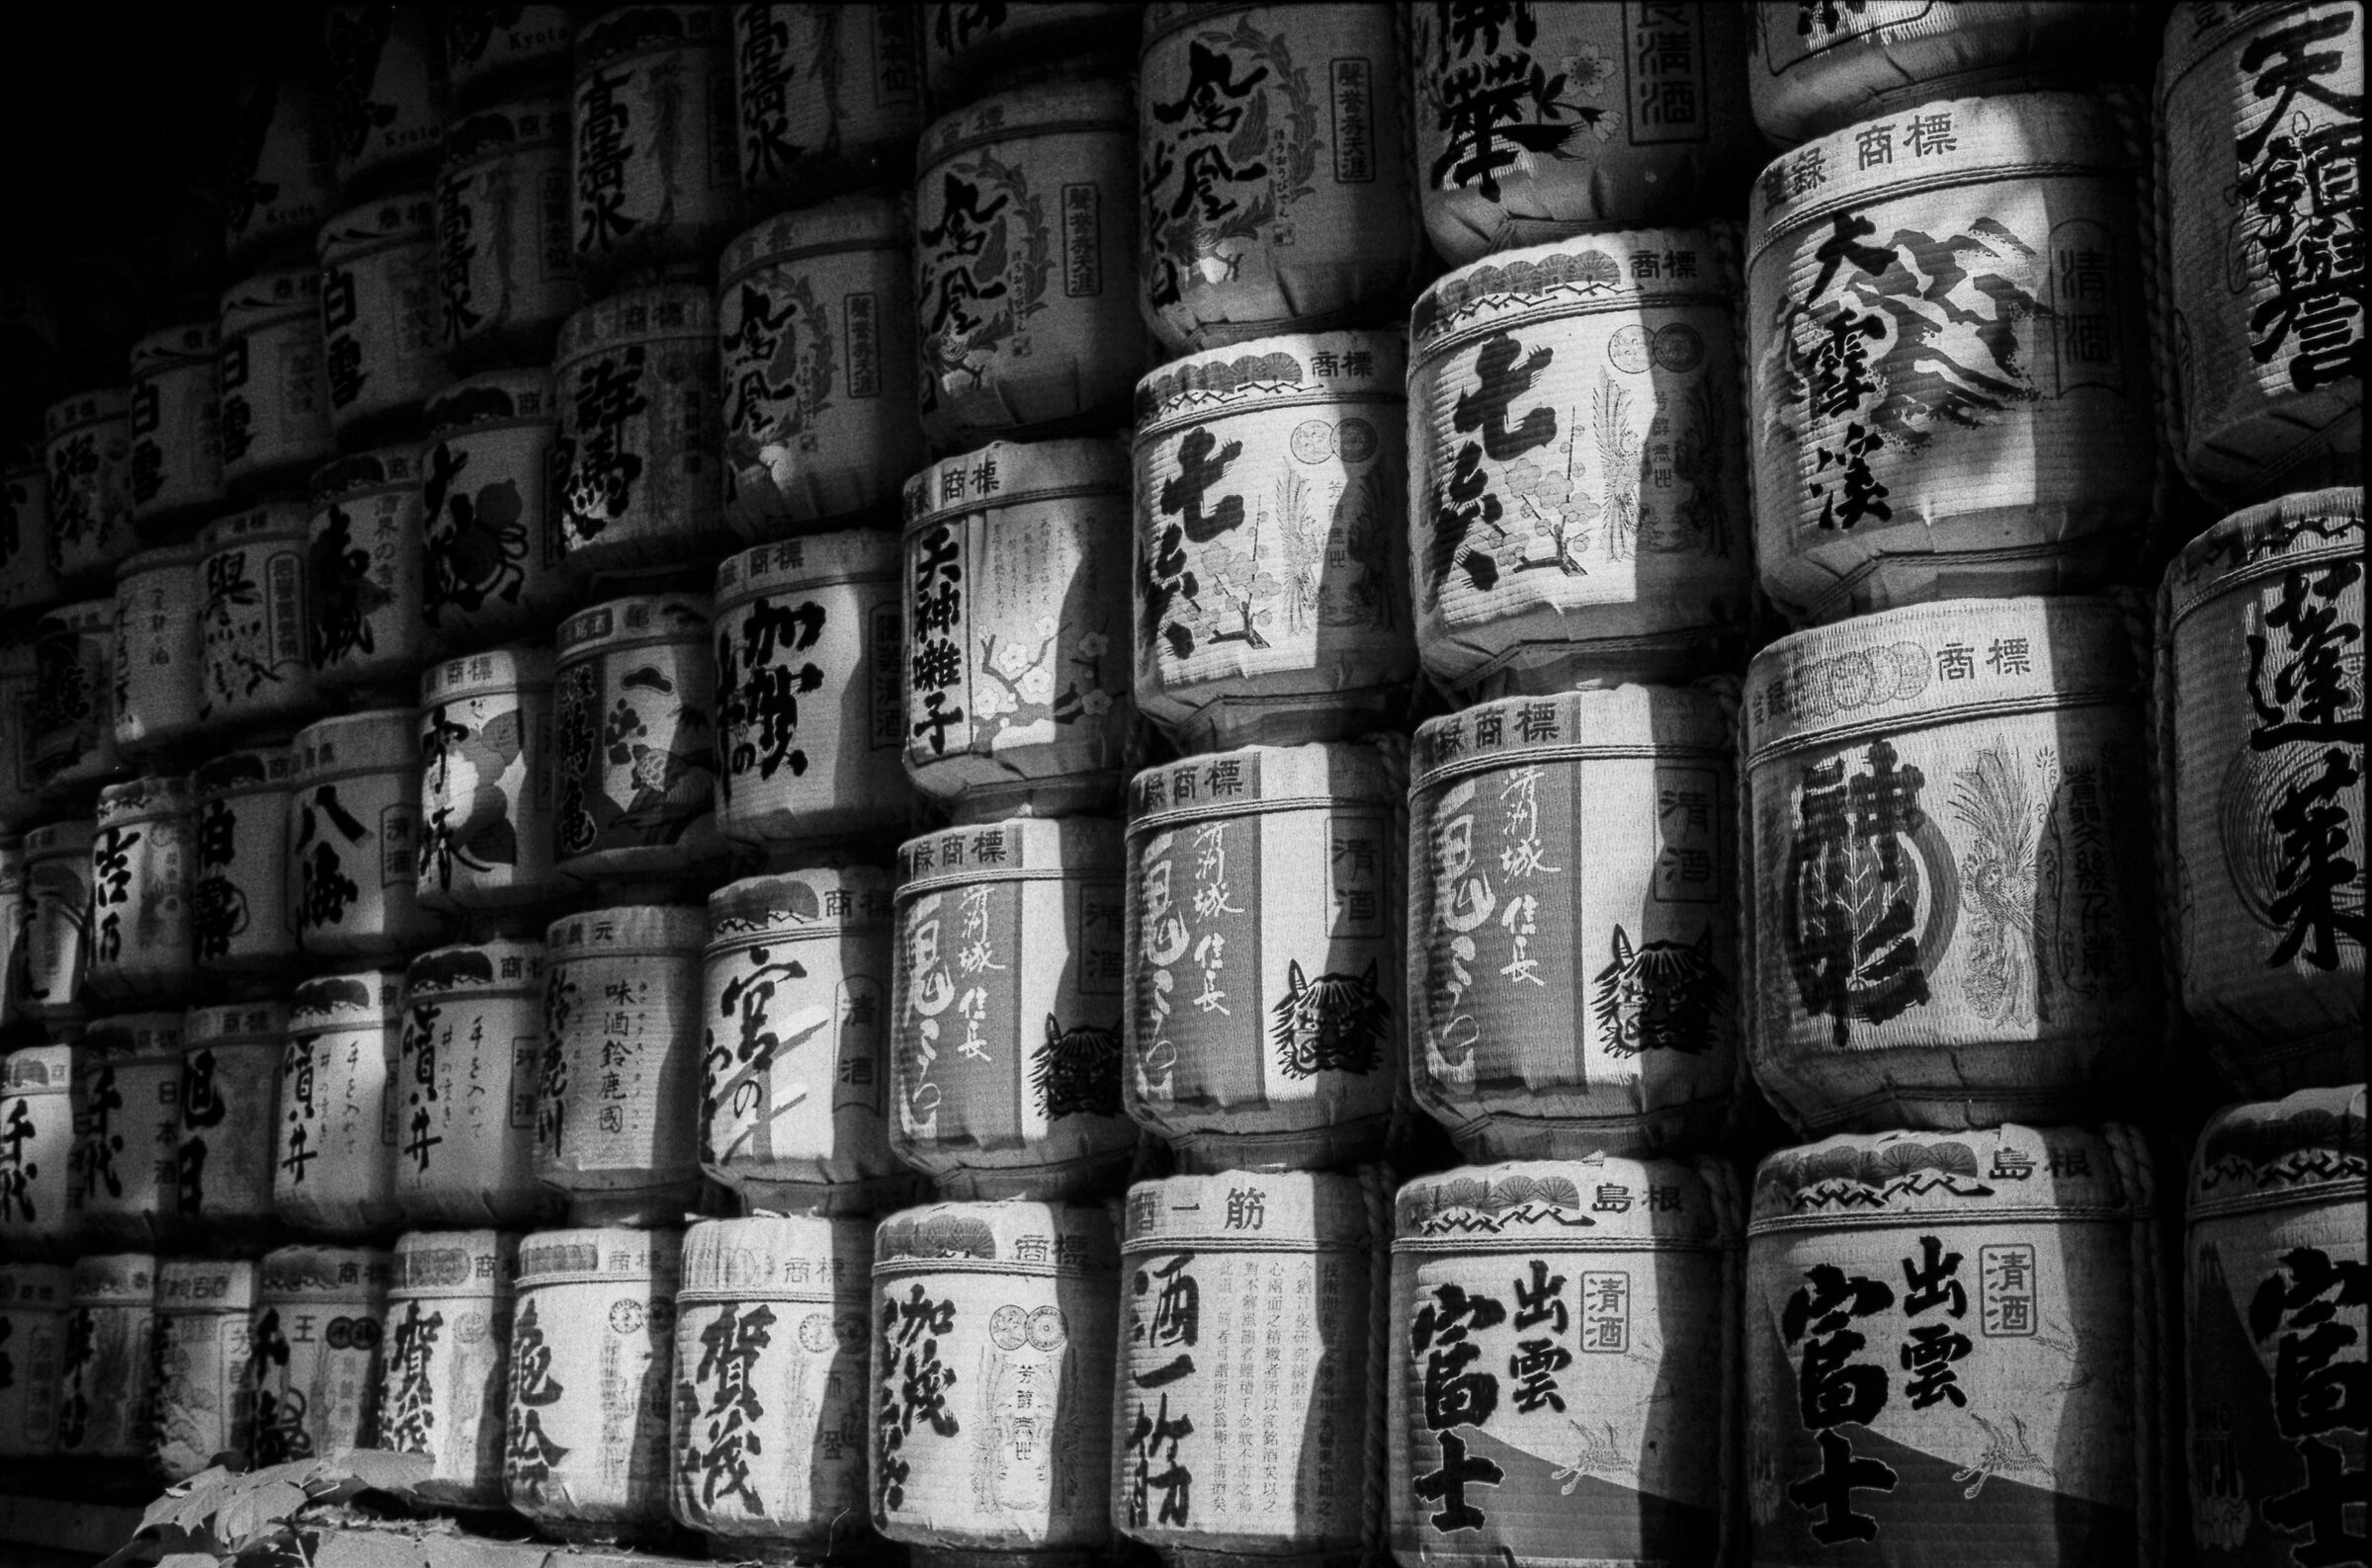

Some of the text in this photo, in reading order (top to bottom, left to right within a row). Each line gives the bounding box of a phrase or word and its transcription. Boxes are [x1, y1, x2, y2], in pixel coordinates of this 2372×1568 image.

[1629, 247, 1698, 281] 商標
[911, 526, 965, 757] 天神囃子
[1933, 634, 2033, 682] 商標
[1659, 788, 1715, 883] 清酒
[1589, 1183, 1682, 1213] 島根
[1987, 1146, 2093, 1182] 島根
[1133, 1188, 1267, 1235] 酒一筋
[1585, 1277, 1629, 1350] 清酒
[1900, 1235, 1973, 1411] 出雲
[1985, 1251, 2032, 1334] 清酒
[1509, 1260, 1573, 1416] 出雲
[1130, 1252, 1200, 1529] 酒一筋
[1411, 1282, 1506, 1533] 富士
[1782, 1263, 1900, 1547] 富士
